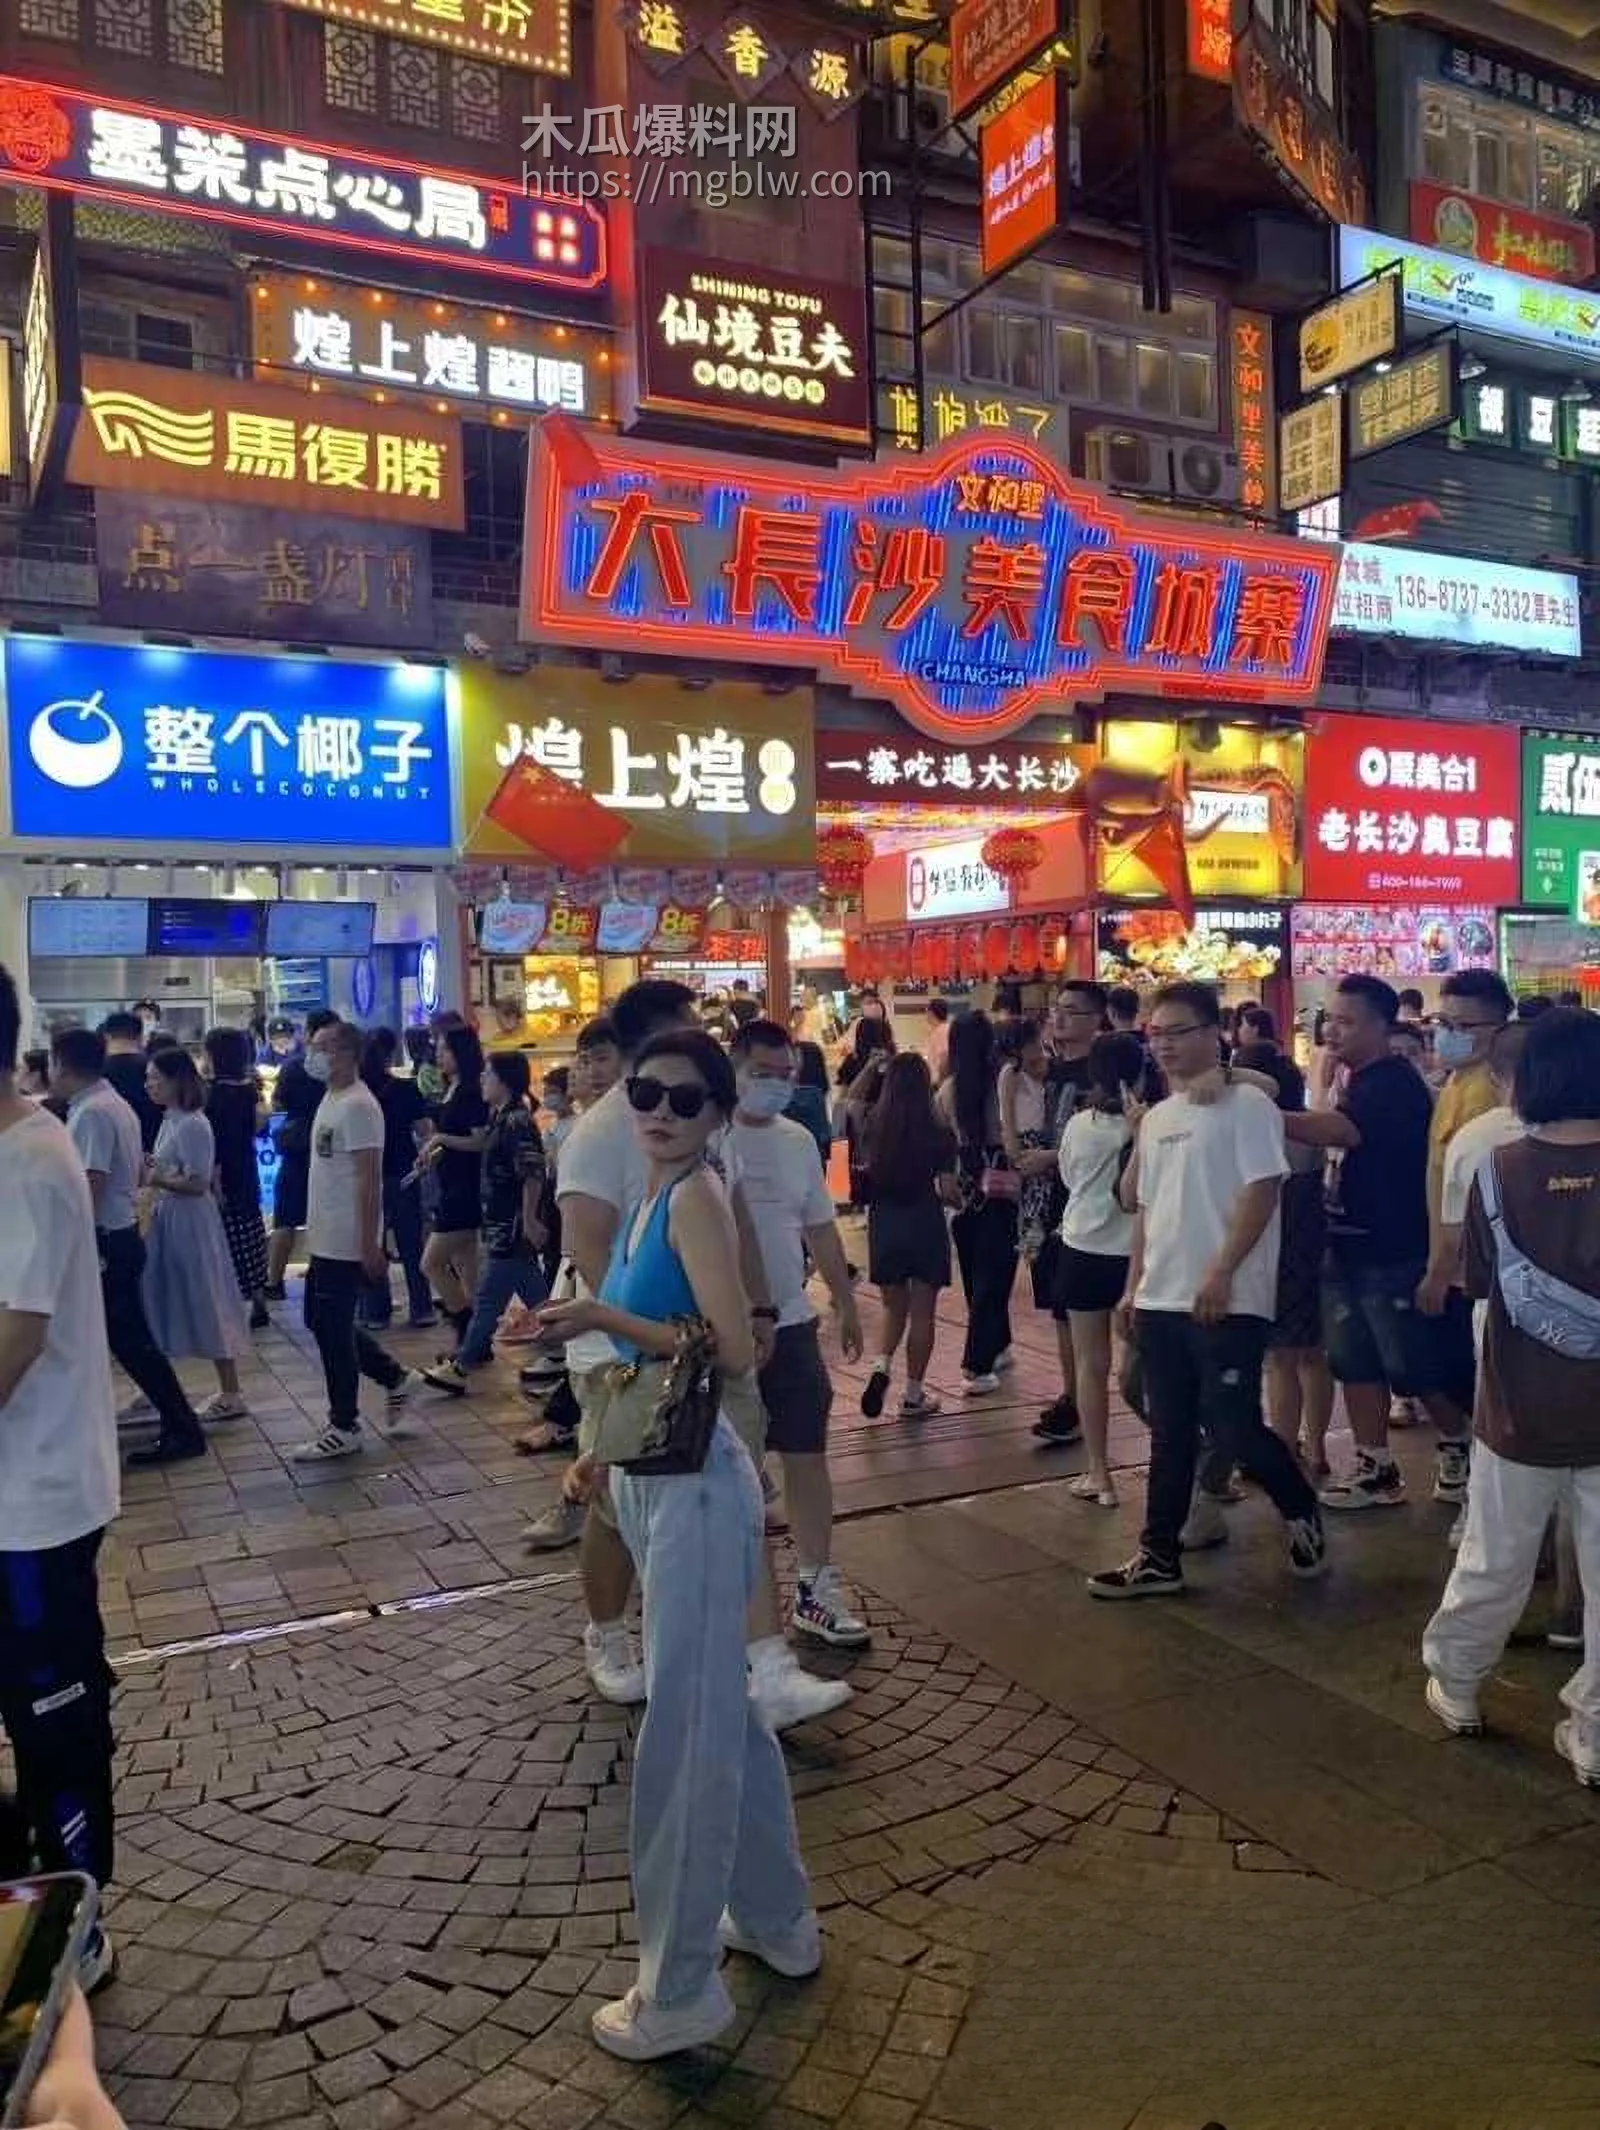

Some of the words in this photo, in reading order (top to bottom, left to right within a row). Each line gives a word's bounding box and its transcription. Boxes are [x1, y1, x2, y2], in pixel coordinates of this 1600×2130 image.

[691, 273, 771, 305] SHINING
[773, 289, 823, 315] TOFU
[657, 292, 856, 378] 仙境豆夫
[224, 410, 443, 500] 馬復勝
[957, 471, 1046, 520] 文和里
[588, 492, 1303, 665] 大長沙美食城寨
[144, 705, 432, 783] 整个椰子
[825, 746, 1081, 793] 一寨吃遍大长沙
[1318, 806, 1515, 860] 老长沙臭豆腐
